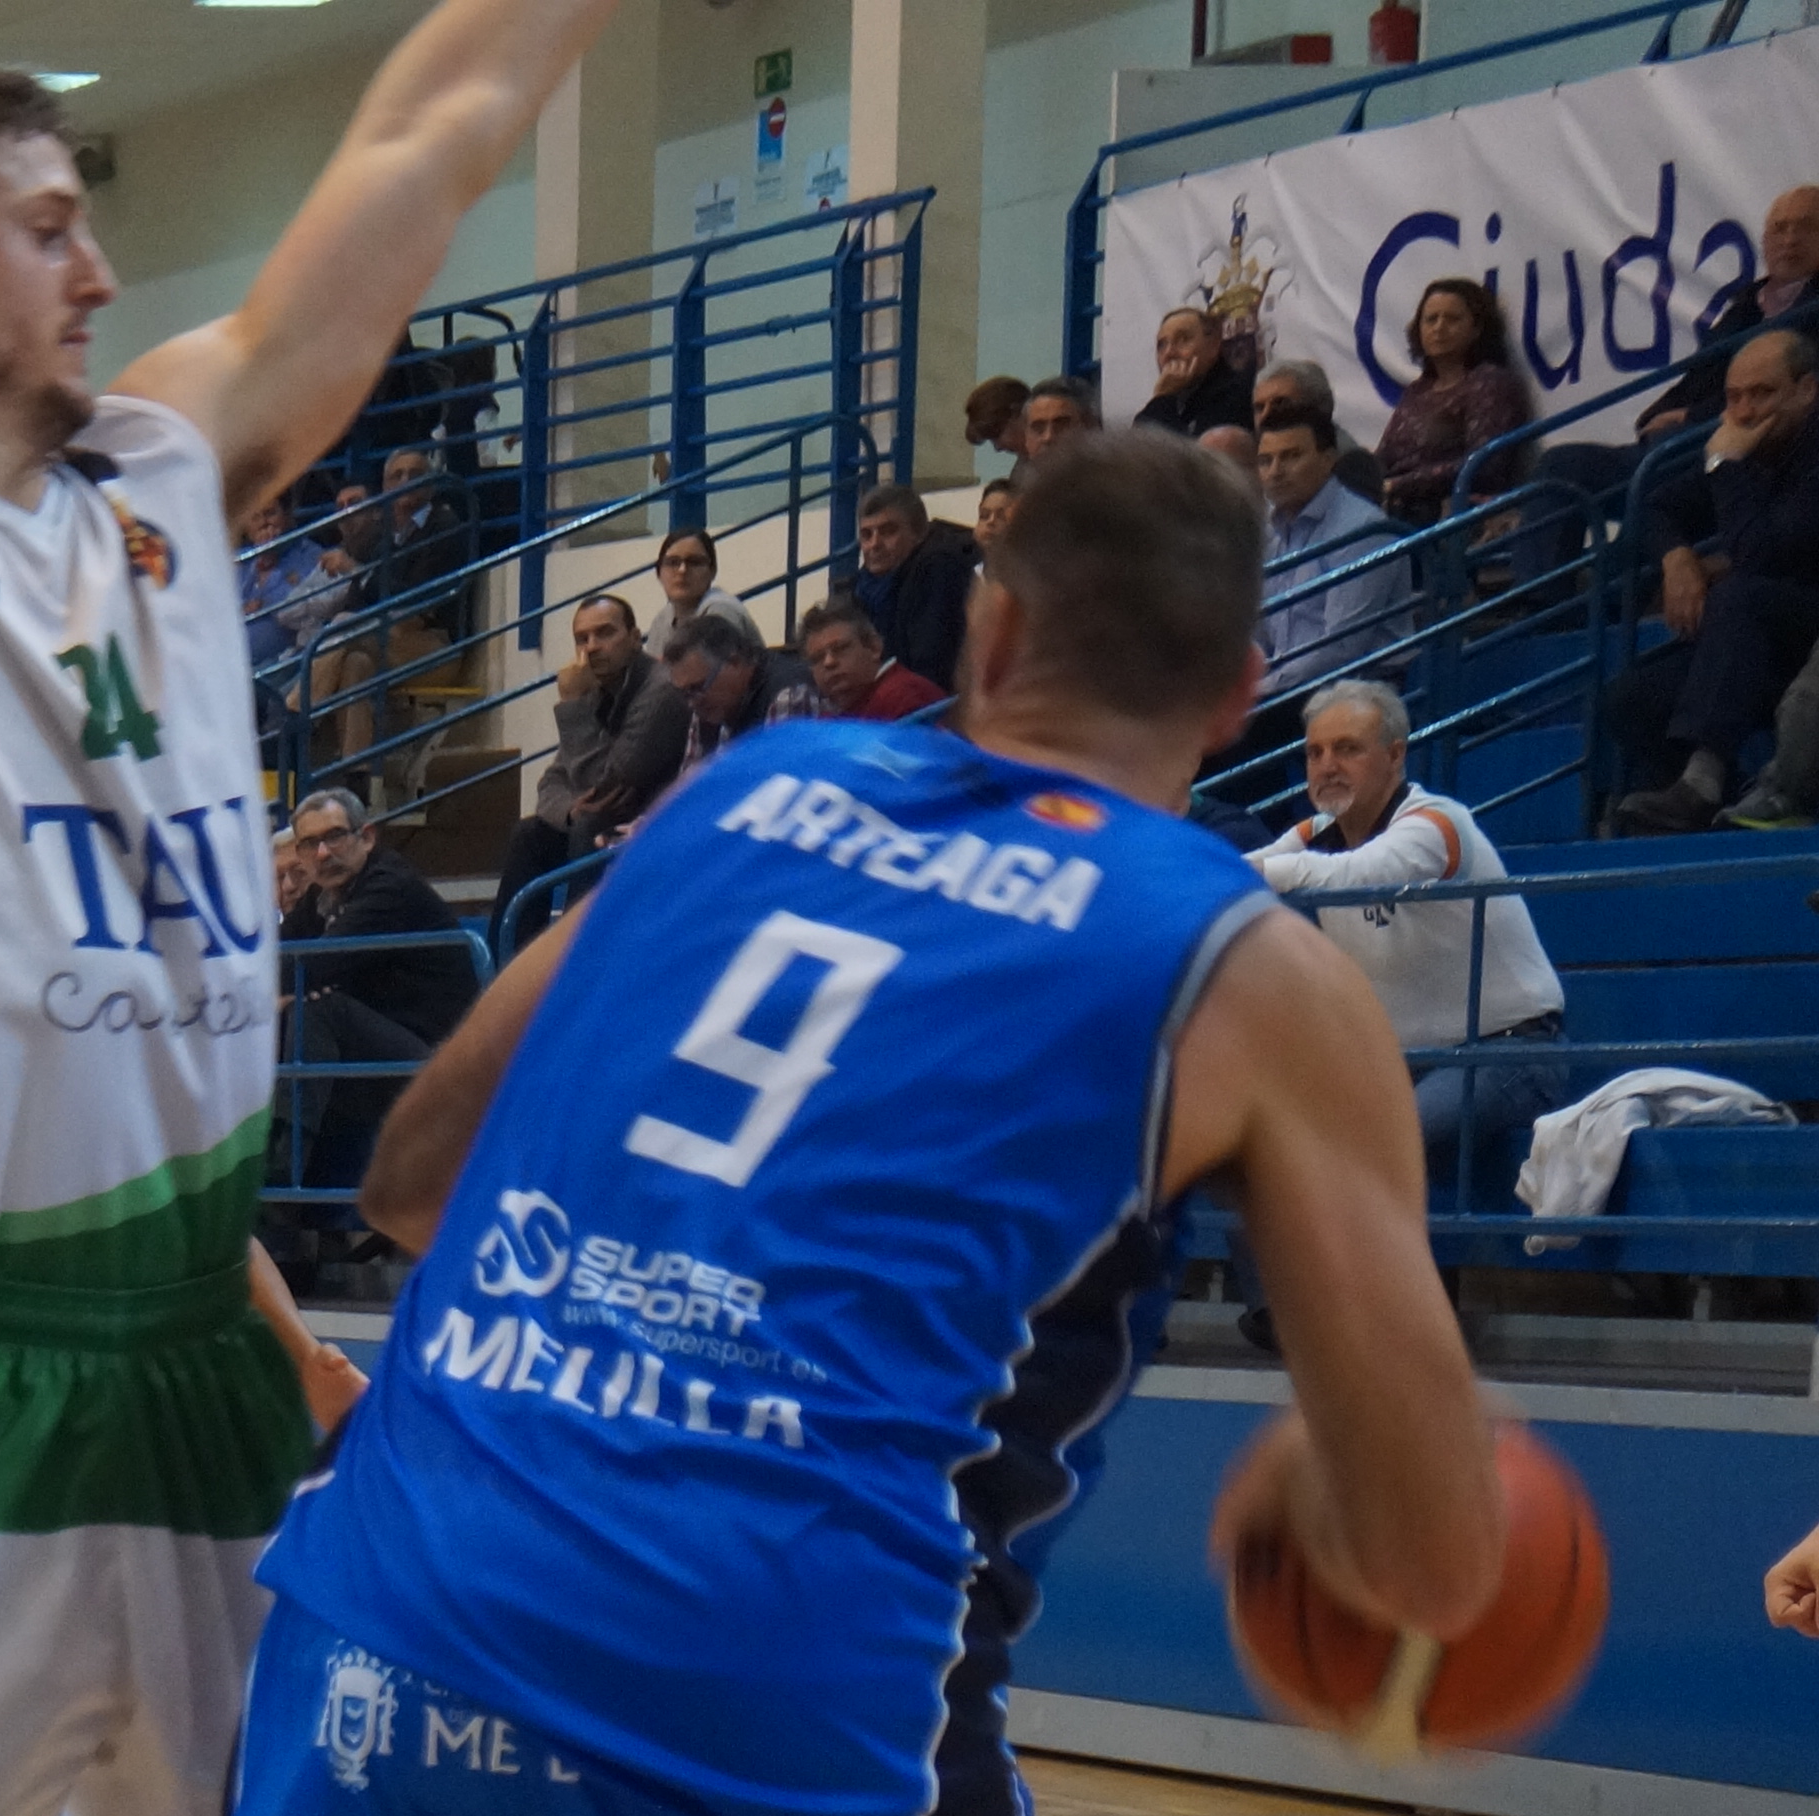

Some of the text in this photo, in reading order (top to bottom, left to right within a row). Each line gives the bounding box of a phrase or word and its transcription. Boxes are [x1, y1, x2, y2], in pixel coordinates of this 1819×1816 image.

[22, 796, 261, 960] TAU
[716, 773, 1103, 932] ARTEAGA
[625, 910, 905, 1189] 9
[425, 1306, 805, 1450] MELILLA
[569, 1267, 762, 1337] SPORT
